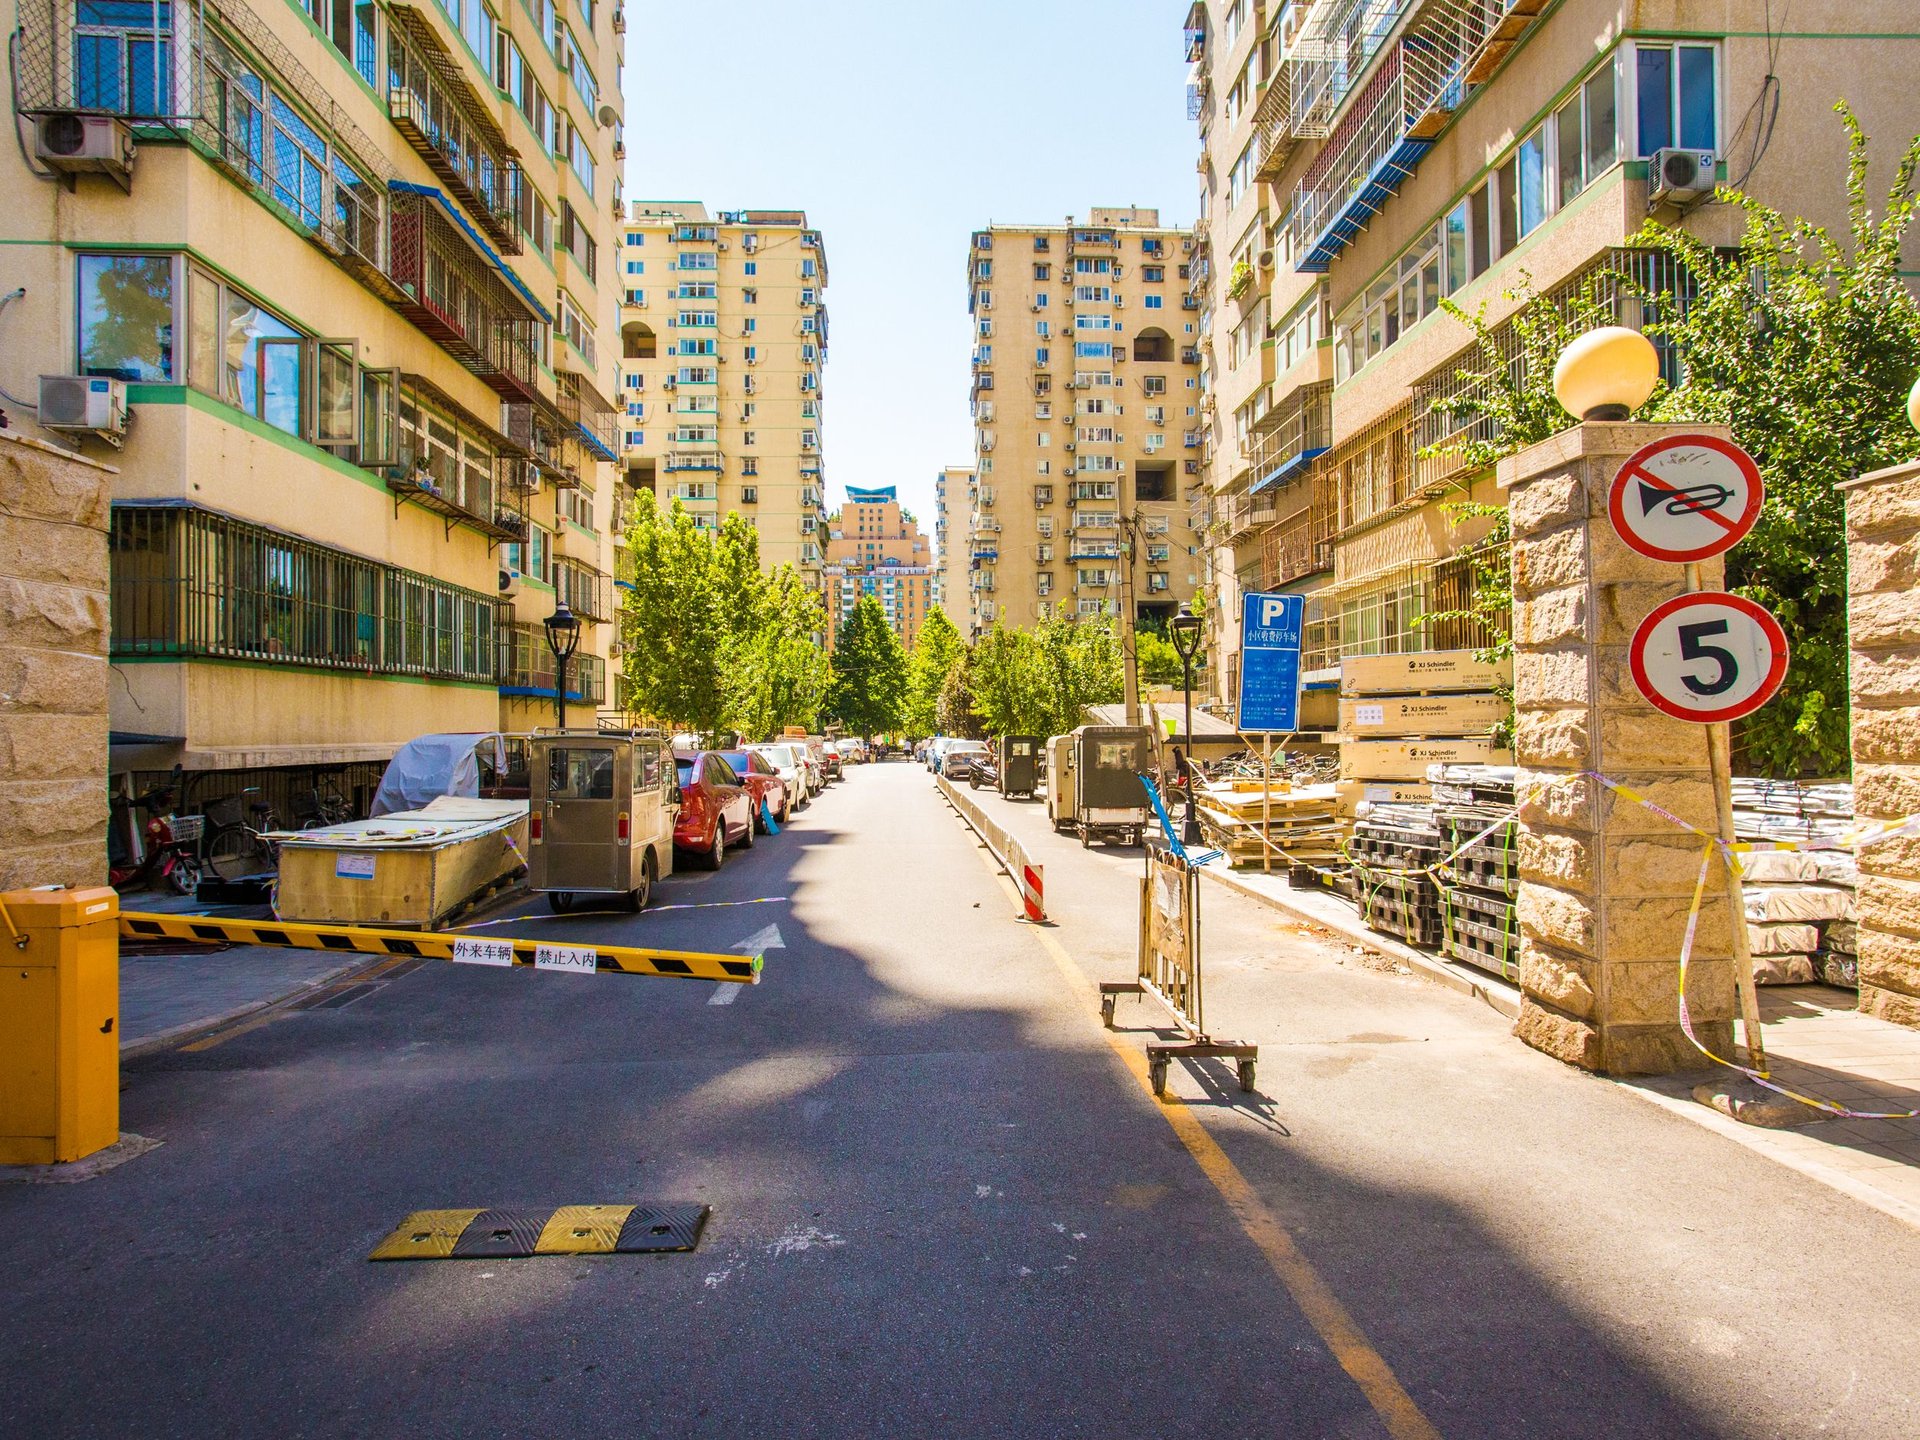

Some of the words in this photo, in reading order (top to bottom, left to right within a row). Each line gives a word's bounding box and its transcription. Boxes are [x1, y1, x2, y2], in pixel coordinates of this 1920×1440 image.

[1262, 599, 1285, 626] P
[1247, 629, 1297, 643] 小区收费停车场
[1678, 619, 1739, 696] 5
[455, 942, 511, 961] 外来车辆
[538, 949, 595, 968] 禁止入内
